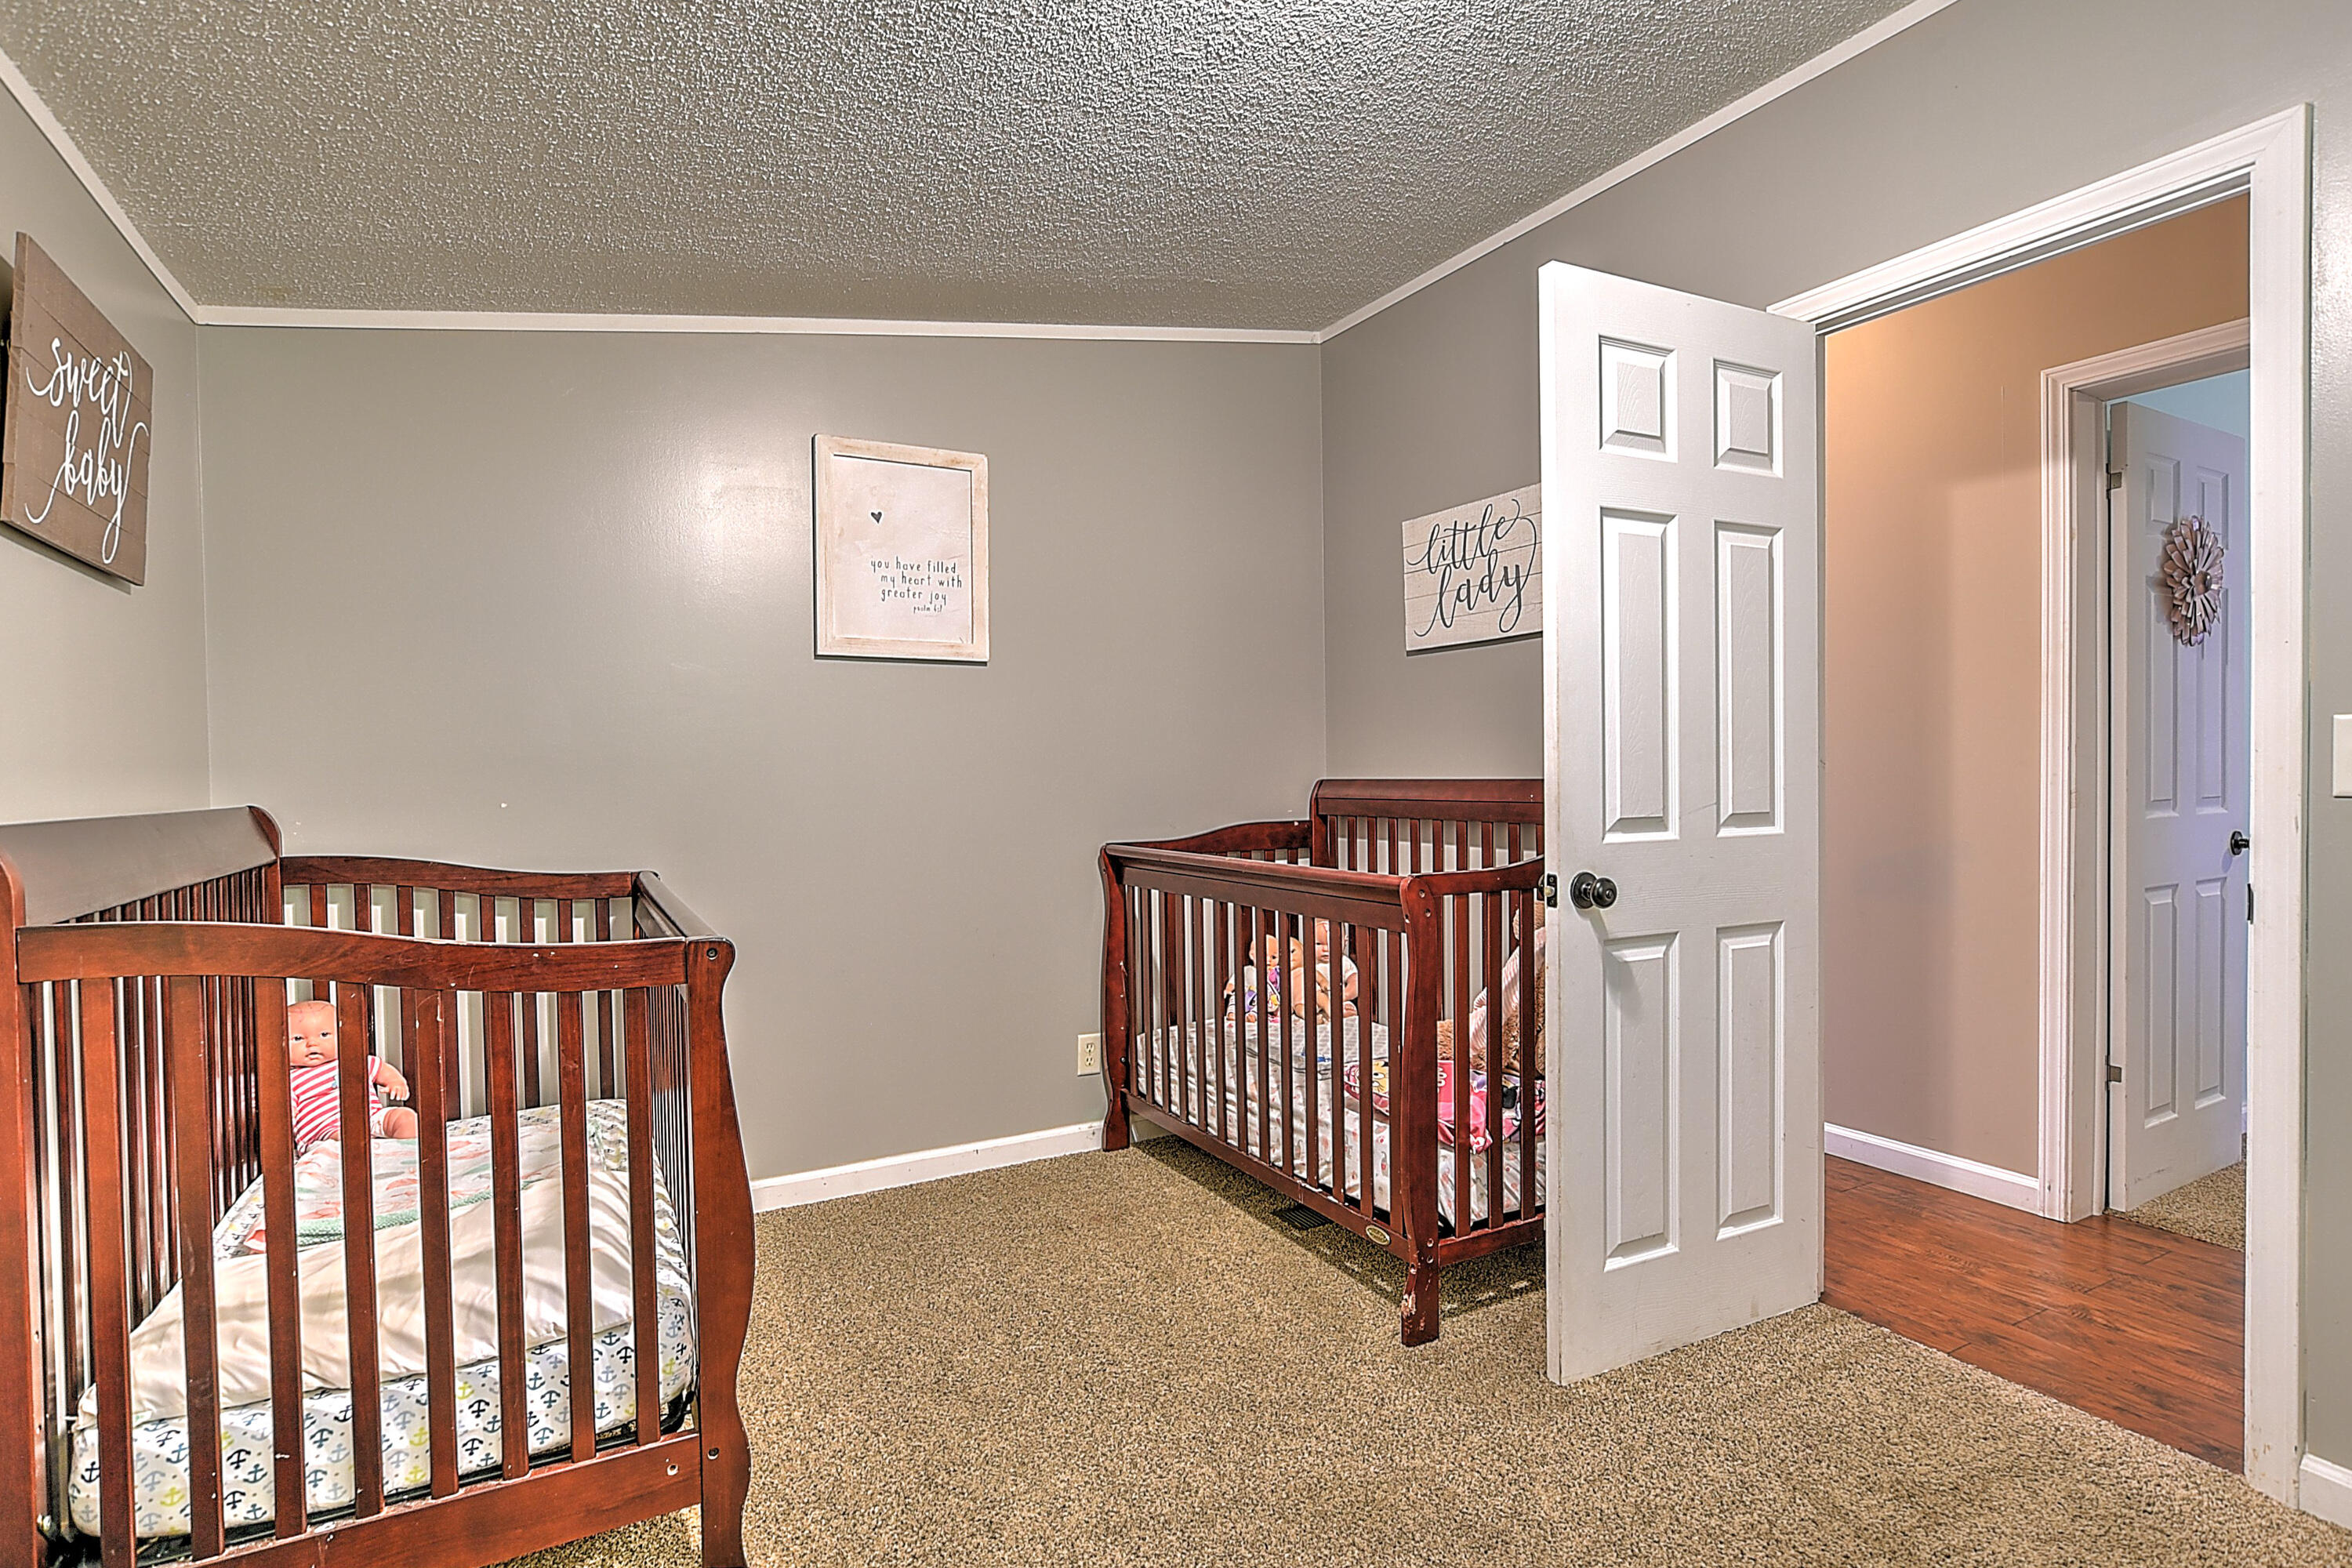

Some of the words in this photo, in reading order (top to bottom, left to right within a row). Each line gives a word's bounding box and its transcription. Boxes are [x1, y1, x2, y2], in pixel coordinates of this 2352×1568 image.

[26, 337, 132, 448] sweet
[24, 409, 149, 564] baby
[870, 560, 890, 573] you
[895, 556, 921, 572] have
[927, 560, 956, 574] filled
[1406, 499, 1520, 574] little
[880, 575, 895, 589] my
[902, 571, 931, 586] heart
[938, 575, 962, 588] with
[881, 586, 923, 602] greater
[929, 591, 946, 606] joy
[1414, 517, 1537, 637] lady
